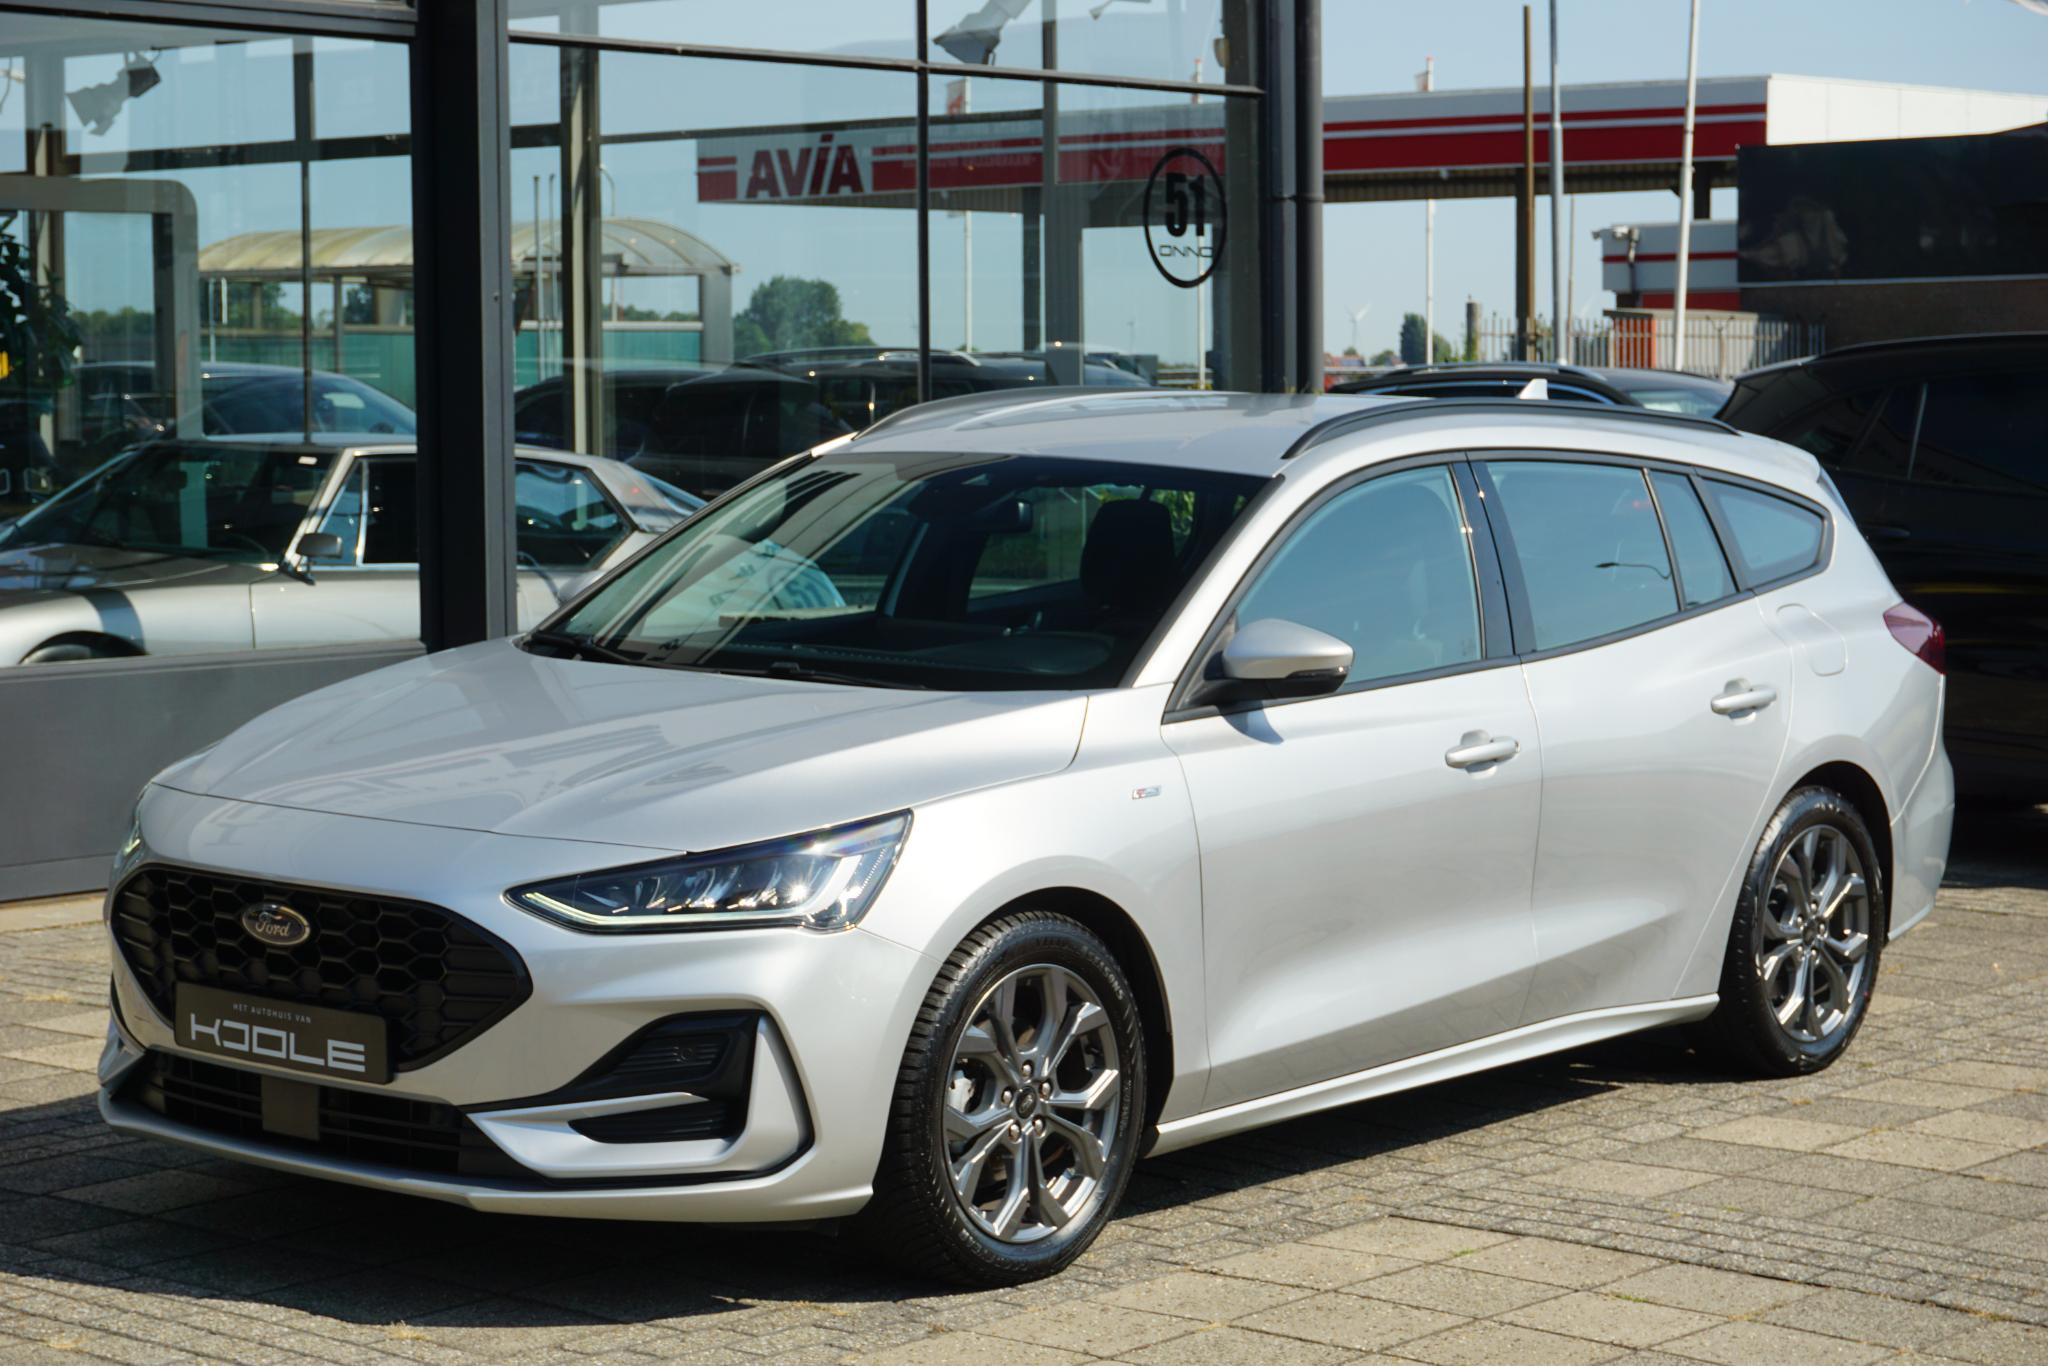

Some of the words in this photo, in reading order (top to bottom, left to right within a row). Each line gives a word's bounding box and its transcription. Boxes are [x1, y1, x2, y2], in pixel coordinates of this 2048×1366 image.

[1166, 173, 1205, 237] 51
[255, 911, 291, 937] Ford
[232, 1003, 248, 1012] HET
[251, 1006, 291, 1020] AUTOHUIS
[295, 1014, 311, 1024] VAN
[190, 1013, 366, 1073] KOOLE
